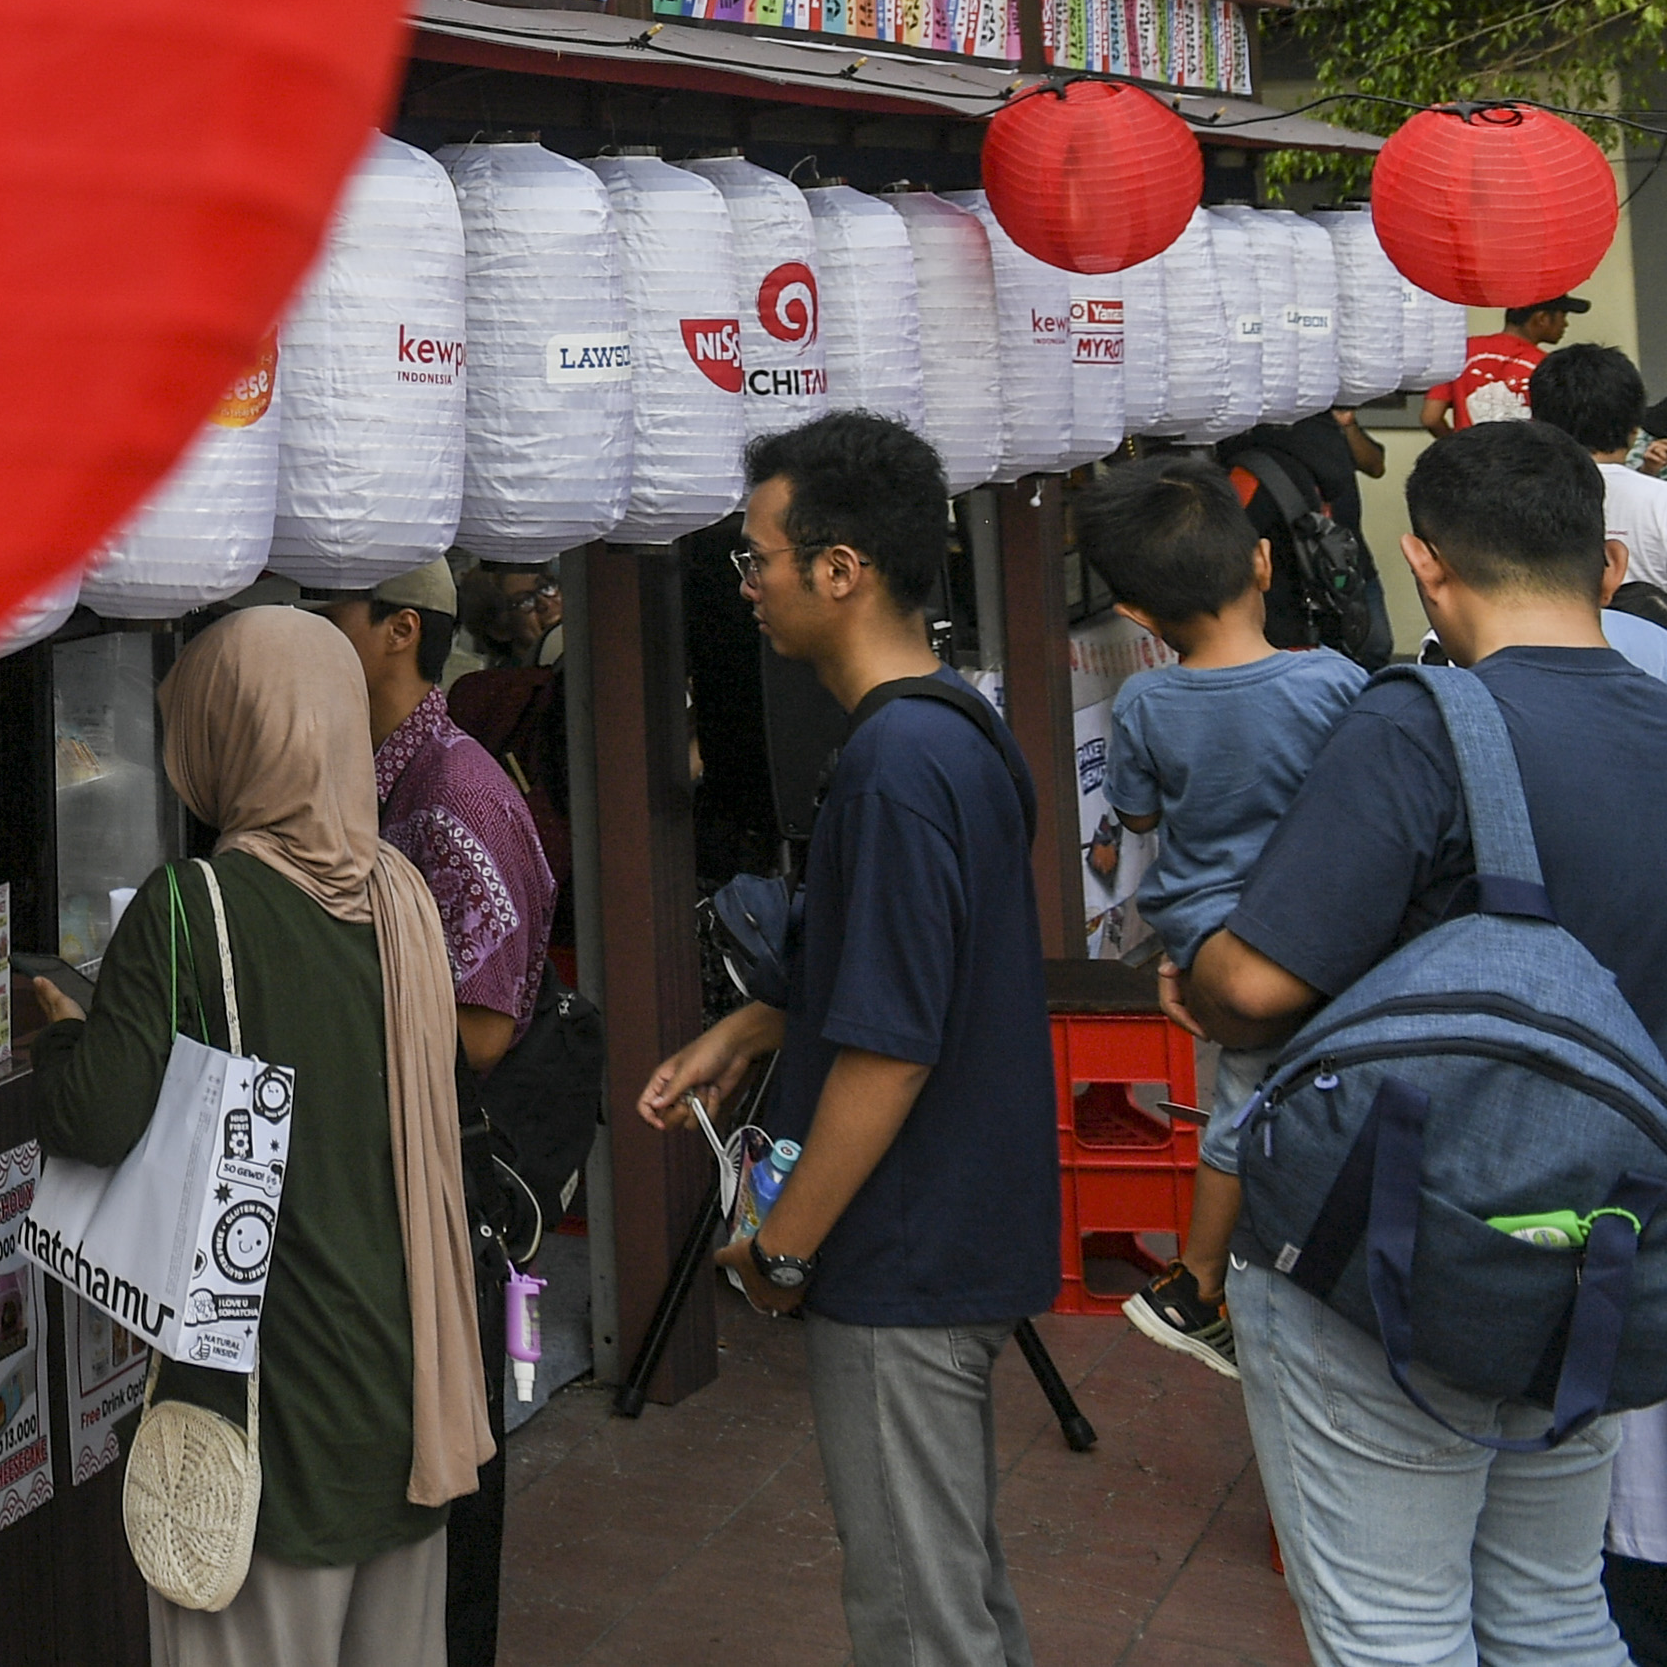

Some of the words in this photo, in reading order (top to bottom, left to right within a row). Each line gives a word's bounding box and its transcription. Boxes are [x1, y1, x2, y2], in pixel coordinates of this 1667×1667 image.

[397, 370, 453, 386] INDONESIA
[223, 1163, 237, 1174] SO
[224, 1204, 256, 1225] GLUTEN
[221, 1299, 242, 1308] LOVE
[204, 1334, 241, 1351] NATURAL
[212, 1346, 239, 1360] INSIDE
[80, 1407, 101, 1431] Free
[101, 1388, 126, 1419] Drink
[4, 1413, 37, 1453] 13.000
